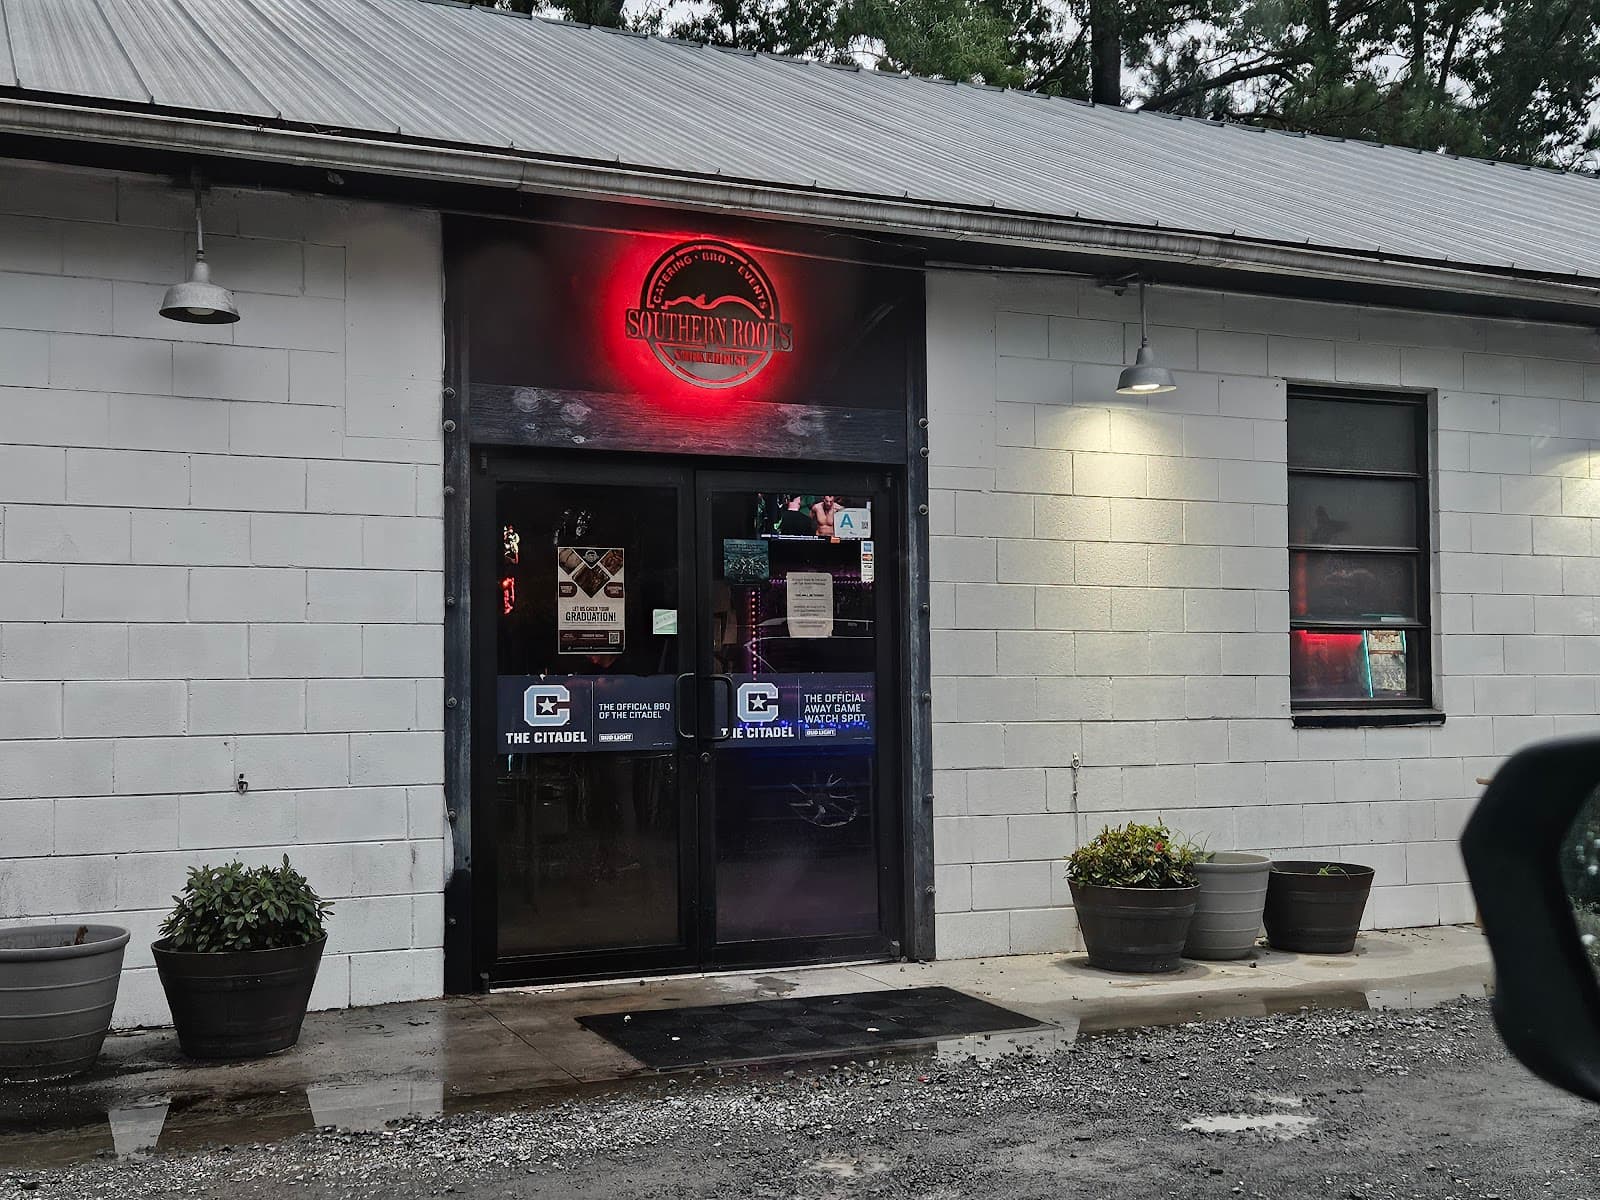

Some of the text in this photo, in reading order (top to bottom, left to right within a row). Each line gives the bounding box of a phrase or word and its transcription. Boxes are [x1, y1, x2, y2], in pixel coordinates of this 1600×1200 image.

[653, 254, 693, 304] CATERING
[737, 265, 768, 310] EVENTS
[627, 309, 792, 350] SOUTHERN ROOTS
[840, 513, 854, 529] A
[565, 611, 617, 622] GRADUATION!
[804, 693, 866, 703] THE OFFICIAL
[599, 702, 671, 711] THE OFFICIAL BBQ
[804, 704, 861, 714] AWAY GAME
[599, 711, 662, 719] OF THE CITADEL
[804, 713, 866, 724] WATCH SPOT
[505, 731, 588, 744] THE CITADEL
[746, 726, 795, 739] CITADEL
